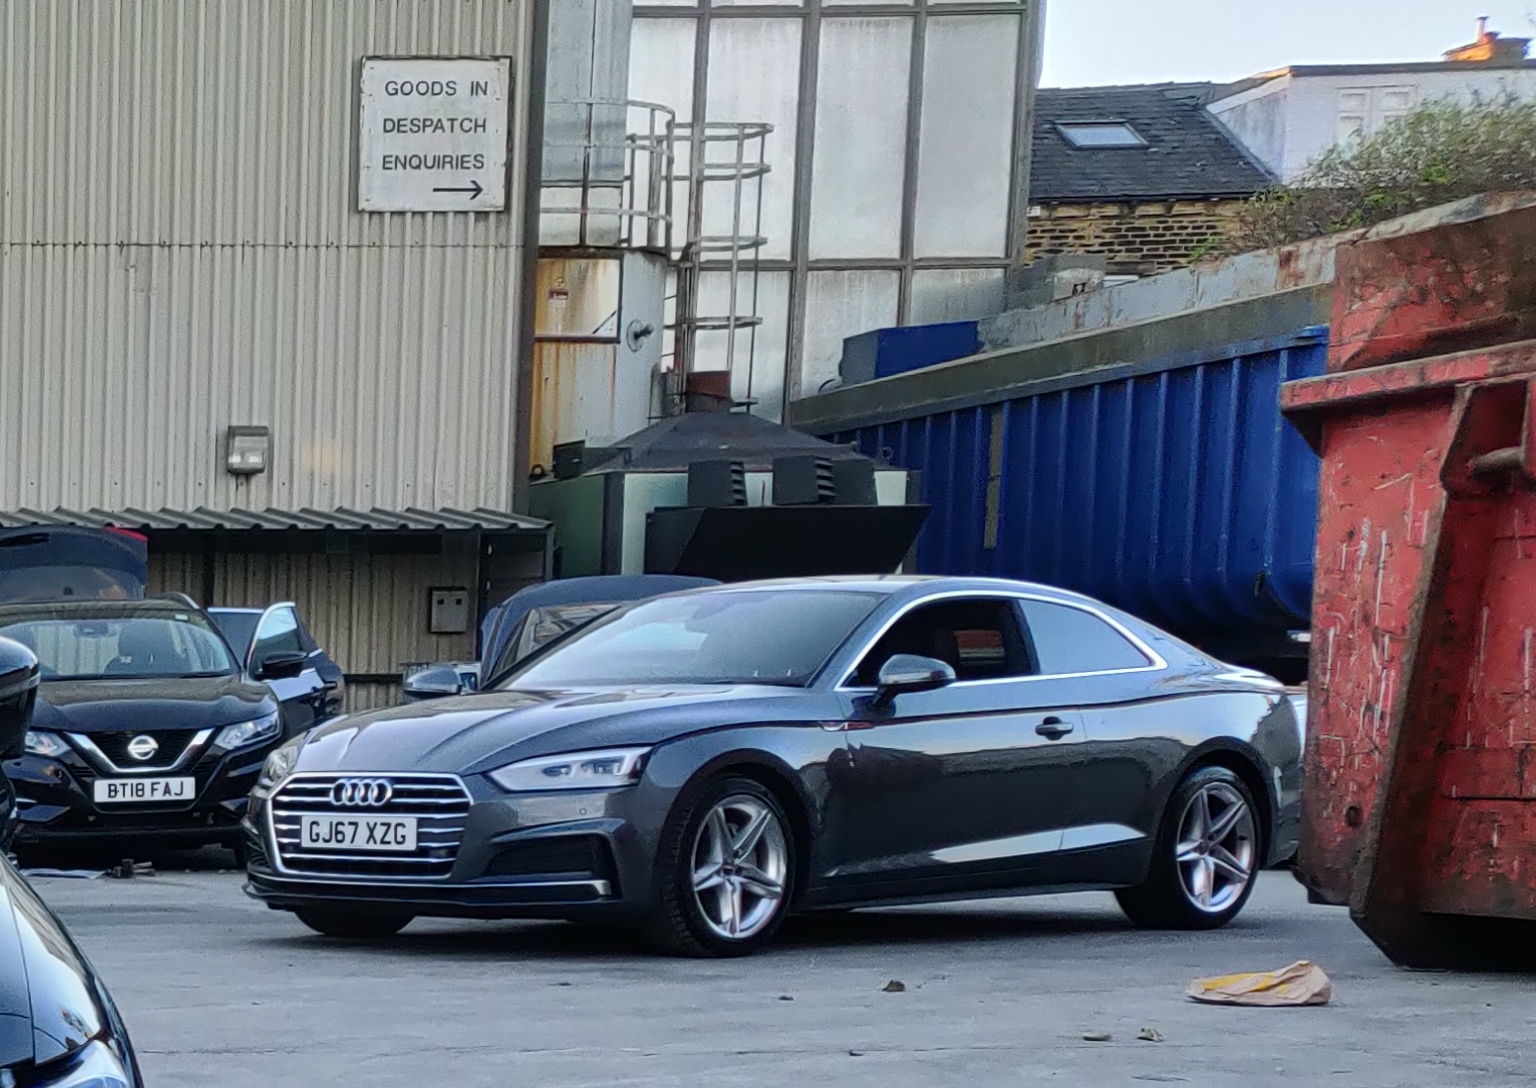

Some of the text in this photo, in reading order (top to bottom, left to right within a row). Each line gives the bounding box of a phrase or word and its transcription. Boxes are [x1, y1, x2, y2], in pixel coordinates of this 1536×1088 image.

[385, 81, 488, 97] GOODS IN
[383, 118, 486, 133] DESPATCH
[382, 154, 485, 170] ENQUIRIES
[151, 781, 184, 797] FAJ
[309, 820, 406, 845] GJ67 XZG
